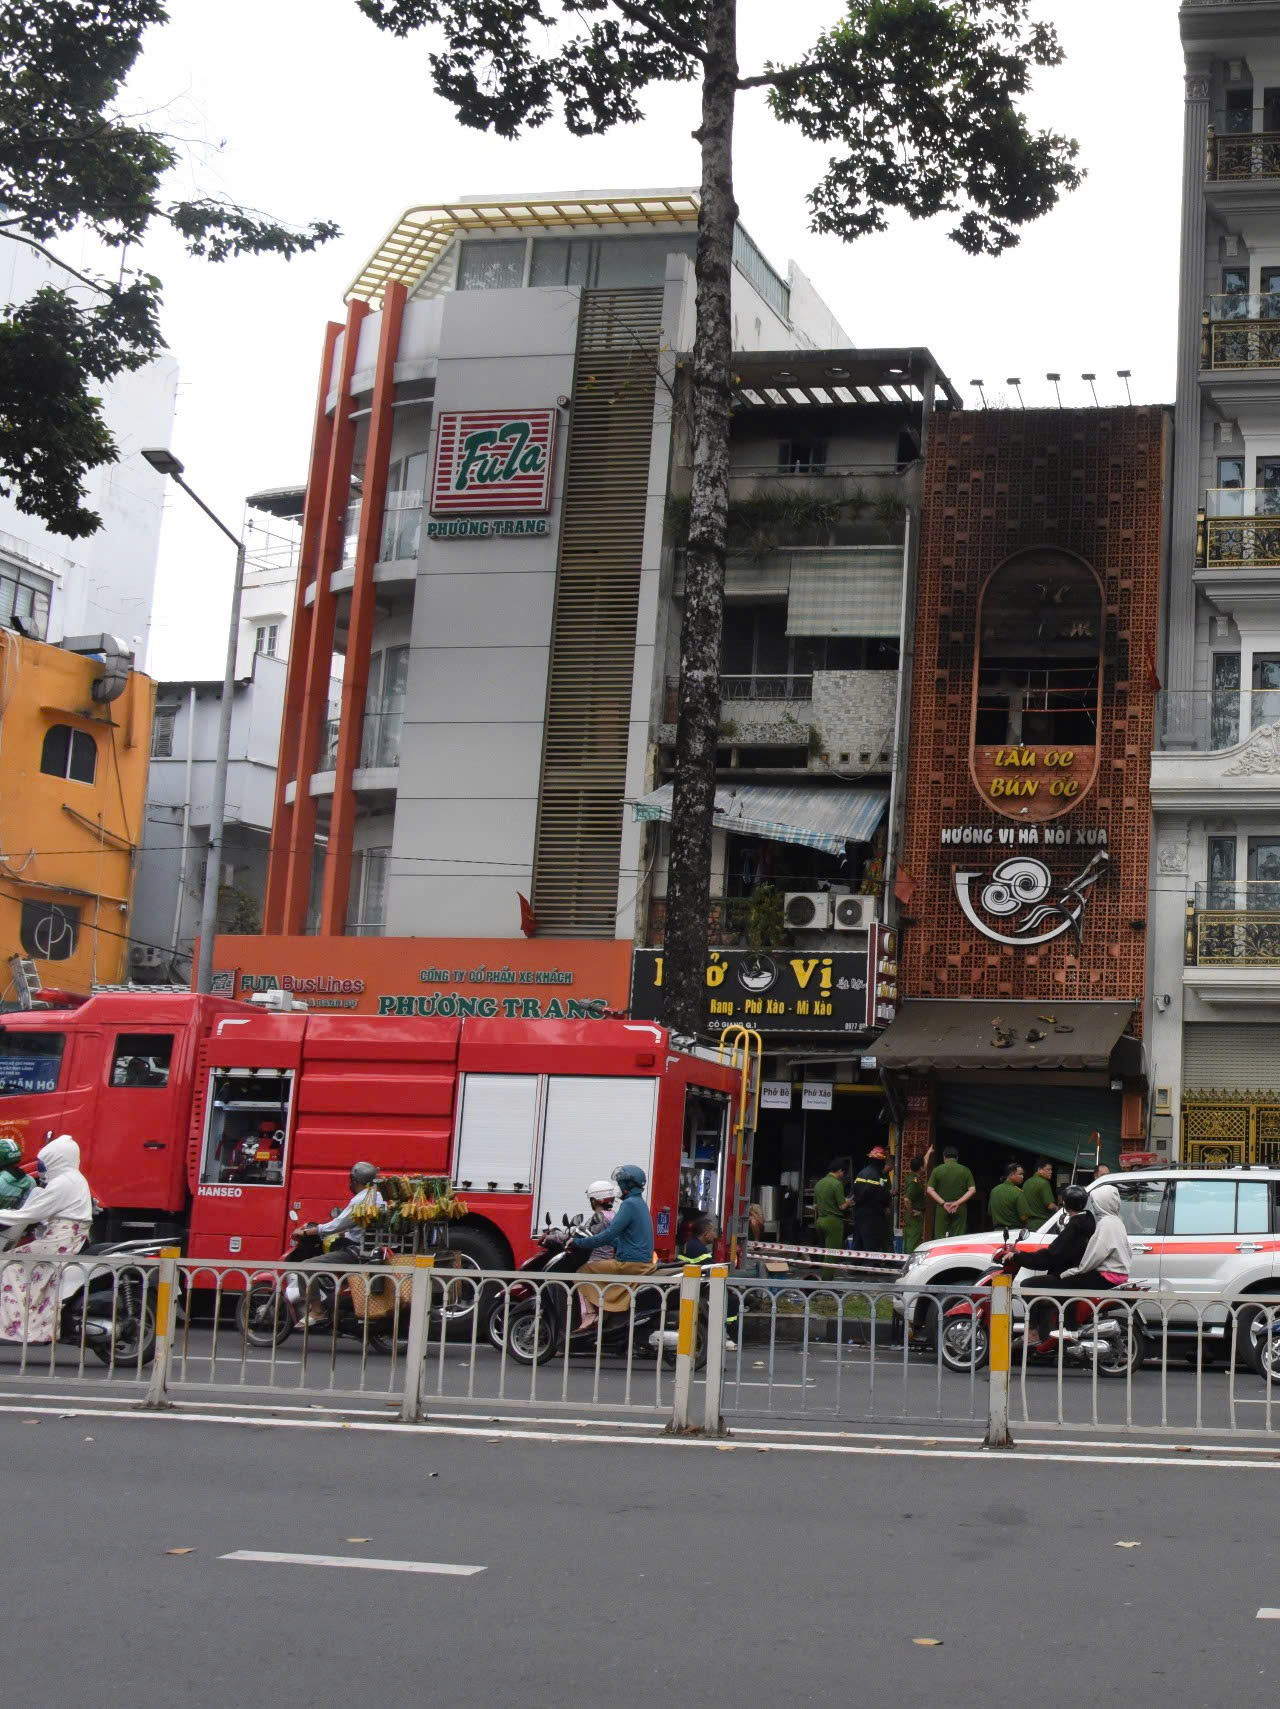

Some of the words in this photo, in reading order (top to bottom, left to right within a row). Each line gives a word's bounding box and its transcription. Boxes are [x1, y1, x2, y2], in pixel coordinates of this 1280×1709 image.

[427, 518, 490, 537] PHƯƠNG
[491, 519, 546, 536] TRANG
[989, 775, 1041, 797] BÚN
[941, 826, 993, 845] HƯƠNG
[998, 828, 1015, 848] VỊ
[1018, 824, 1039, 845] HÀ
[1075, 827, 1108, 845] XƯA
[241, 975, 280, 992] FUTA
[419, 966, 450, 983] CÔNG
[452, 970, 466, 984] TY
[518, 970, 534, 984] XE
[535, 967, 574, 985] KHÁCH
[789, 958, 833, 998] Vị
[377, 992, 500, 1018] PHƯƠNG
[501, 997, 609, 1019] TRANG
[710, 998, 734, 1016] Rang
[745, 998, 763, 1015] Phở
[766, 1000, 785, 1015] Xào
[796, 1000, 809, 1016] Mì
[813, 1001, 833, 1017] Xào
[763, 1087, 779, 1097] Phở
[780, 1087, 790, 1097] Bò
[197, 1186, 243, 1198] HANSEO
